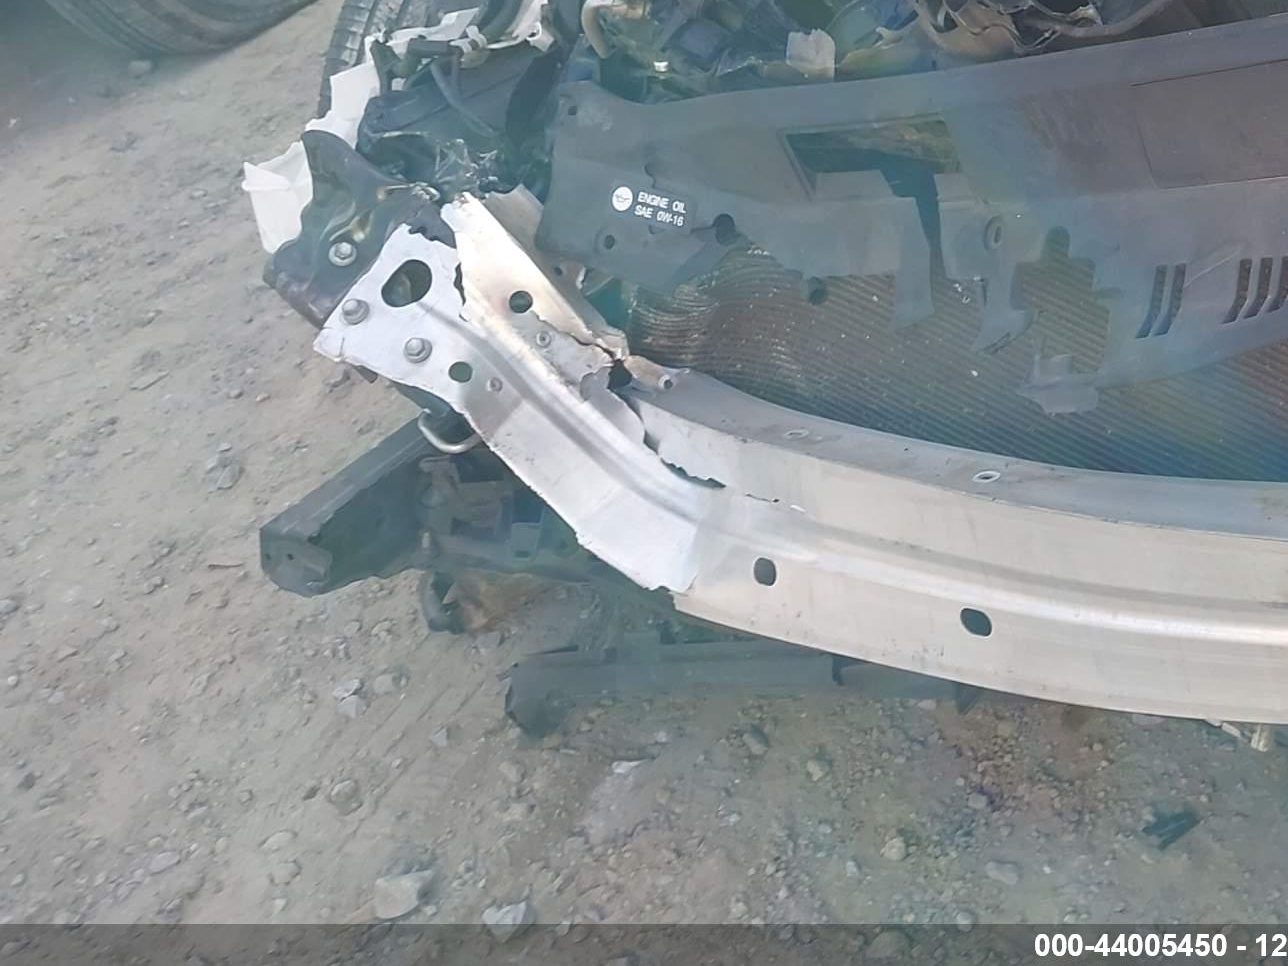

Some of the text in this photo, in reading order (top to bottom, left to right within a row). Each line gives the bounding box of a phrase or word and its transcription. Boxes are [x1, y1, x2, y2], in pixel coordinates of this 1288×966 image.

[637, 191, 686, 213] ENGINE OIL
[634, 204, 684, 226] SAE 0W-16
